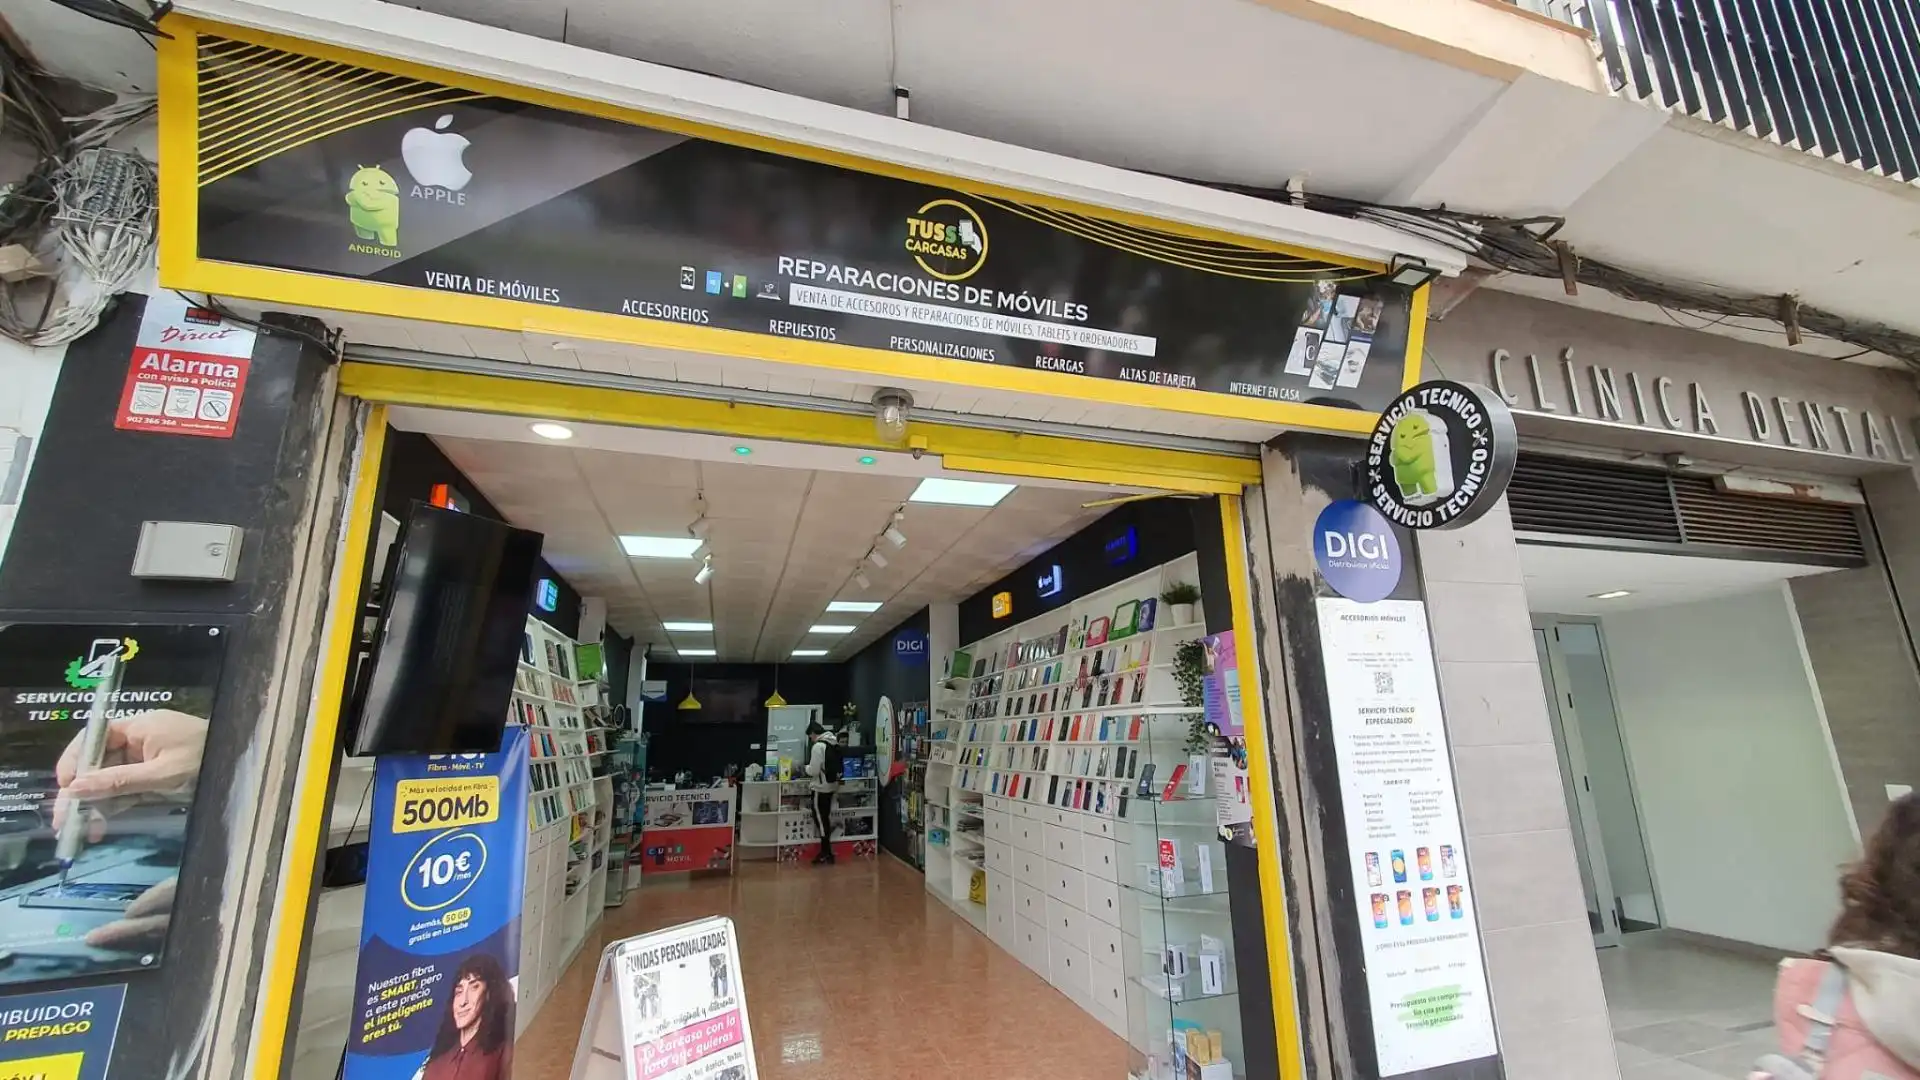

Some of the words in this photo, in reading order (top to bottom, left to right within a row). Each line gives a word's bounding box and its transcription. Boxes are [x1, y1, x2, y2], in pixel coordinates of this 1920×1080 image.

[410, 184, 466, 206] APPLE
[348, 243, 401, 259] ANDROID
[906, 239, 967, 260] CARCASAS
[426, 271, 471, 293] VENTA
[476, 278, 496, 296] DE
[499, 279, 560, 304] MÓVILES
[779, 256, 959, 302] REPARACIONES
[964, 286, 992, 308] DE
[997, 289, 1089, 321] MÓVILES
[623, 300, 710, 324] ACCESOREIOS
[796, 288, 828, 306] VENTA
[830, 294, 844, 308] DE
[903, 303, 910, 317] Y
[912, 304, 980, 329] REPARACIONES
[982, 318, 994, 330] DE
[1072, 332, 1078, 342] Y
[1080, 334, 1139, 351] ORDENADORES
[160, 326, 239, 343] Direct
[769, 320, 837, 341] REPUESTOS
[890, 335, 995, 362] PERSONALIZACIONES
[140, 353, 240, 379] Alarma
[1035, 355, 1085, 374] RECARGAS
[137, 373, 158, 381] con
[160, 375, 189, 384] aviso
[1120, 366, 1148, 384] ALTAS
[1149, 371, 1161, 385] DE
[1162, 372, 1197, 389] TARJETA
[1230, 381, 1267, 399] INTERNET
[1268, 387, 1279, 399] EN
[1280, 387, 1301, 401] CASA
[1493, 347, 1719, 436] CLÍNICA
[1369, 395, 1416, 466] SERVICIO
[1420, 388, 1482, 429] TECNICO
[1740, 390, 1913, 461] DENTAL
[1373, 484, 1434, 527] SERVICIO
[1436, 448, 1488, 521] TECNICO
[1325, 531, 1389, 560] DIGI
[897, 640, 924, 651] DIGI
[15, 692, 96, 704] SERVICIO
[29, 710, 70, 721] TUSS
[1358, 707, 1387, 715] SERVICIO
[1366, 718, 1413, 726] ESPECIALIZADO
[428, 764, 448, 772] Fibra
[402, 794, 489, 826] 500Mb
[446, 914, 456, 923] 50
[458, 911, 469, 920] GB
[409, 934, 431, 946] gratis
[432, 930, 442, 938] en
[452, 923, 469, 933] nube
[661, 931, 727, 964] PERSONALIZADAS
[369, 974, 409, 993] Nuestra
[412, 964, 435, 979] fibra
[367, 996, 379, 1005] es
[420, 974, 443, 989] pero
[365, 1010, 374, 1018] a
[375, 1001, 398, 1015] este
[400, 988, 431, 1008] precio
[1390, 997, 1427, 1010] Presupuesto
[1435, 1004, 1454, 1014] previa
[364, 1020, 375, 1031] el
[377, 998, 433, 1026] inteligente
[706, 1023, 724, 1035] con
[726, 1015, 736, 1028] la
[1406, 1020, 1430, 1030] Servicio
[1430, 1014, 1464, 1026] garantizado
[5, 1021, 92, 1042] PREPAGO
[363, 1028, 387, 1043] eres
[696, 1033, 733, 1054] quieras
